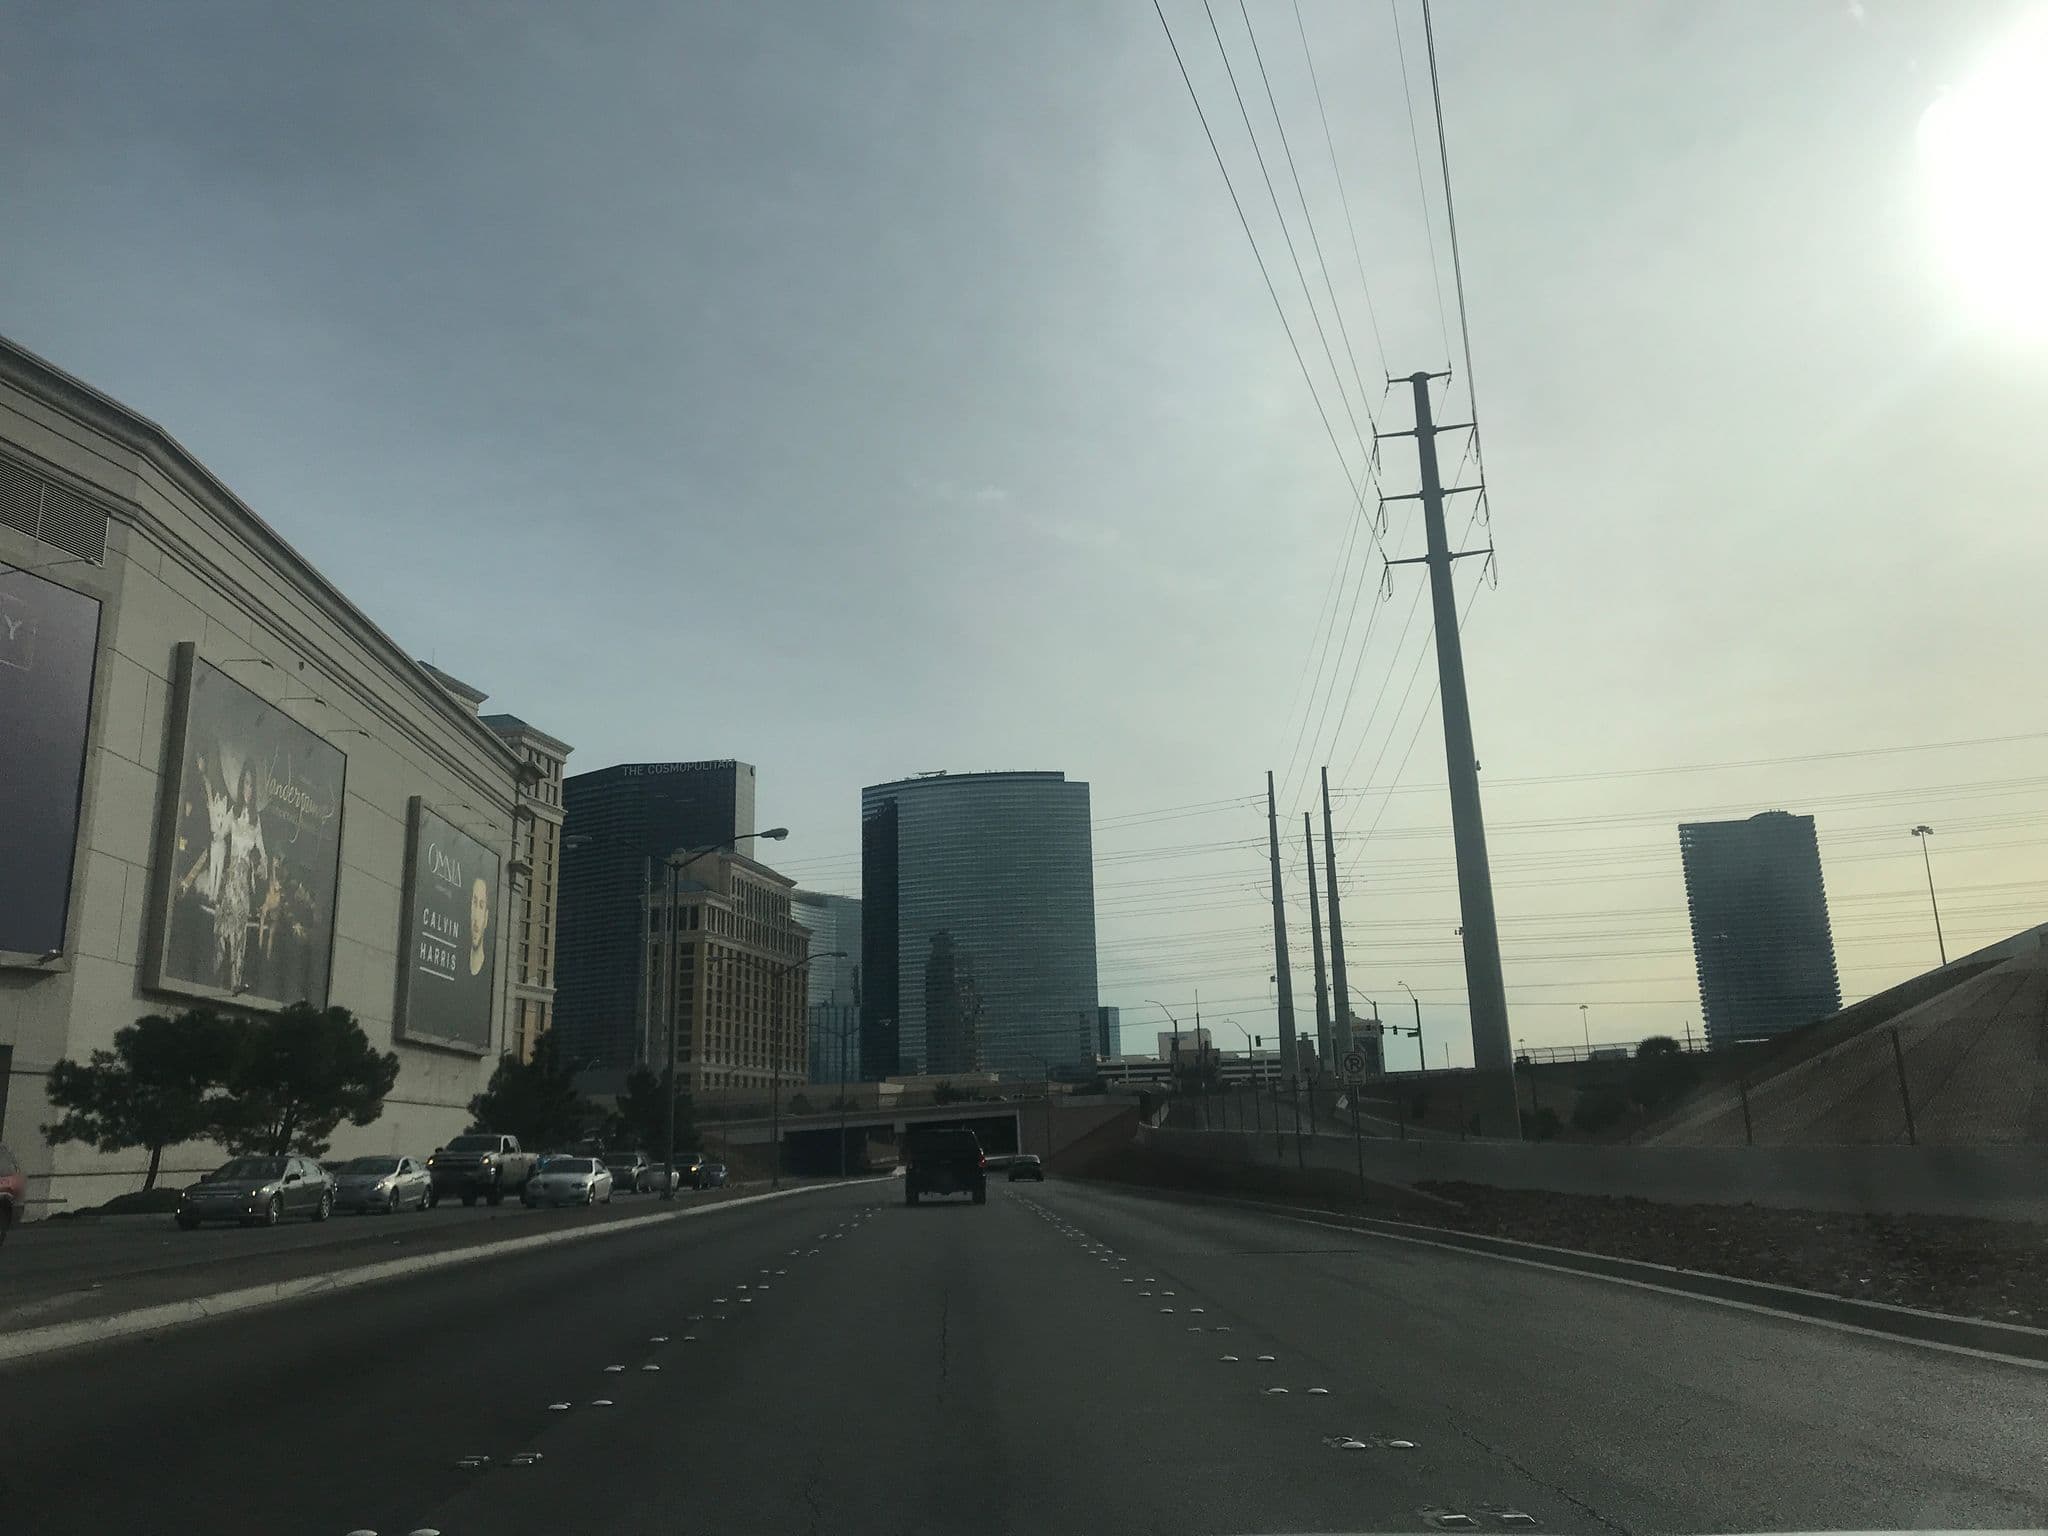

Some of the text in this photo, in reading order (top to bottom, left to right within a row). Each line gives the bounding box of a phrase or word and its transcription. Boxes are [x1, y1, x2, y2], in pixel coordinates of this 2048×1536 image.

[623, 760, 735, 776] THE COSMOPOLITAN
[423, 908, 459, 938] CALVIN
[420, 942, 456, 971] HARRIS
